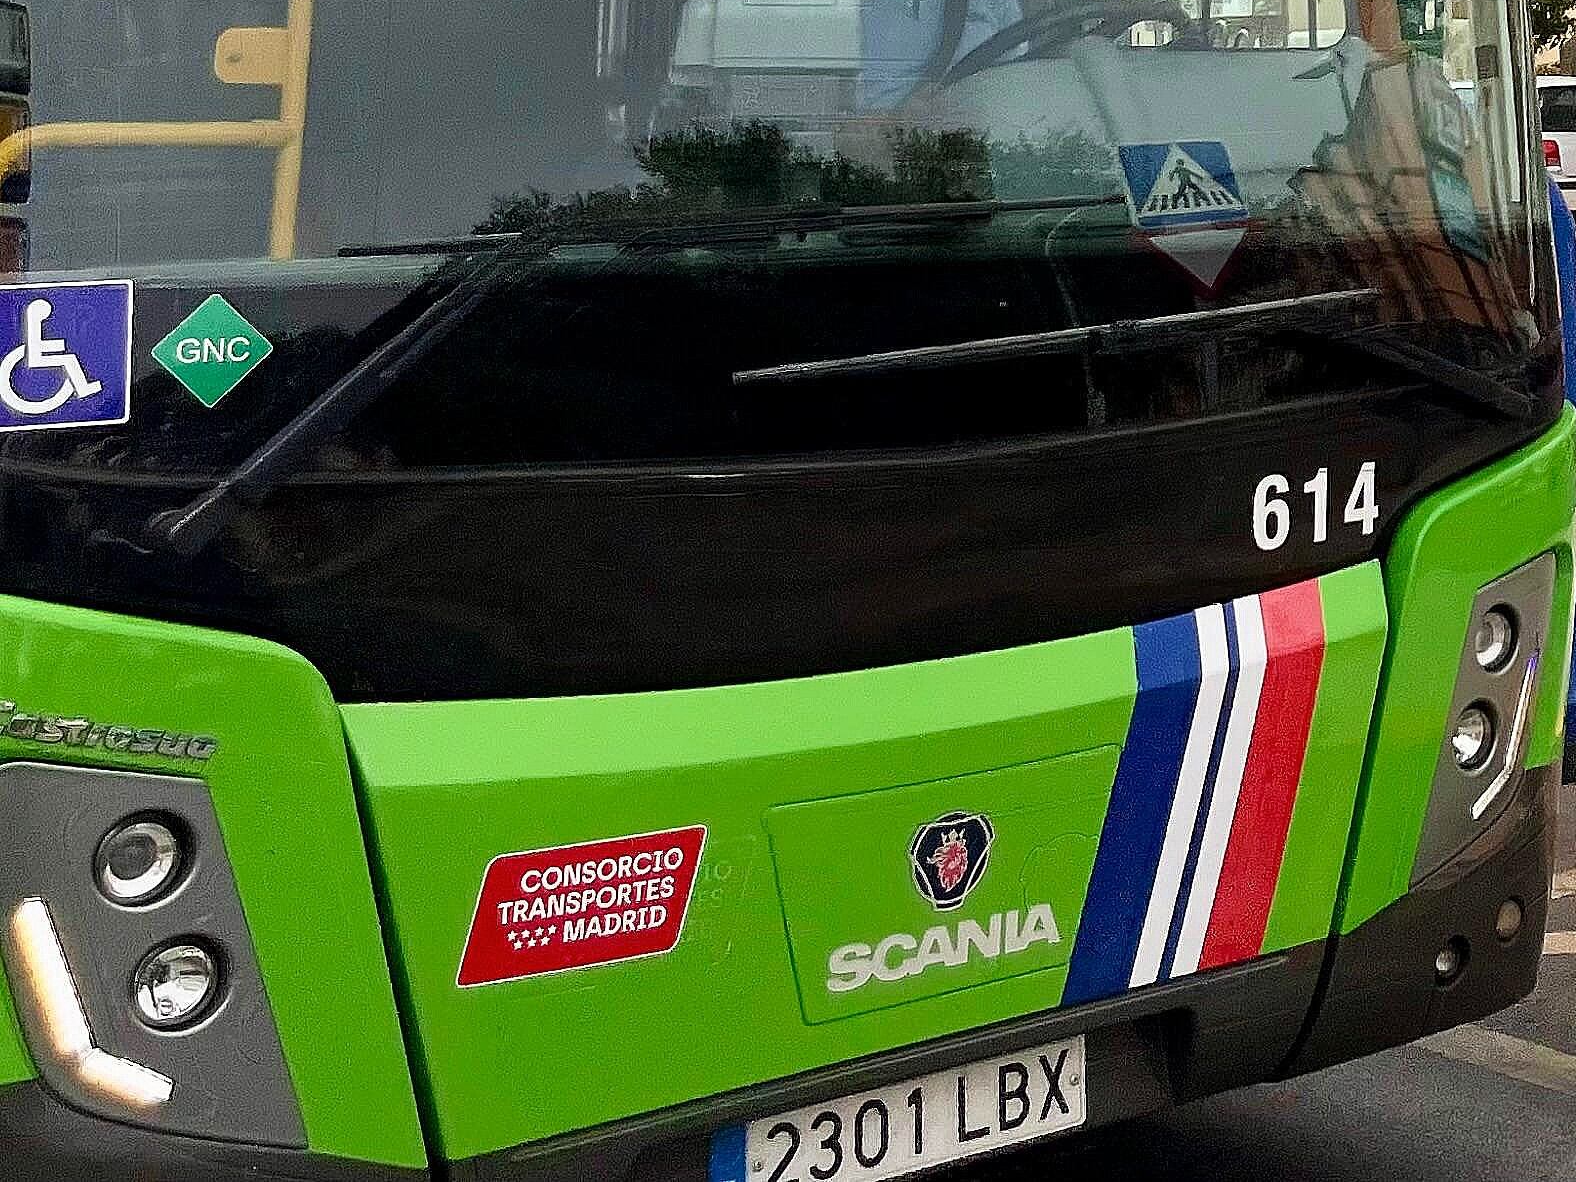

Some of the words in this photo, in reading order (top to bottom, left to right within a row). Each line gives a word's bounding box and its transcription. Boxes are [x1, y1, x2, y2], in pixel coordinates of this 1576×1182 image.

[176, 336, 250, 364] GNC
[1252, 461, 1380, 551] 614
[520, 846, 684, 894] CONSORCIO
[497, 874, 676, 926] TRANSPORTES
[562, 904, 668, 943] MADRID
[826, 903, 1063, 992] SCANIA
[765, 1086, 925, 1182] 2301
[956, 1048, 1071, 1144] LBX
